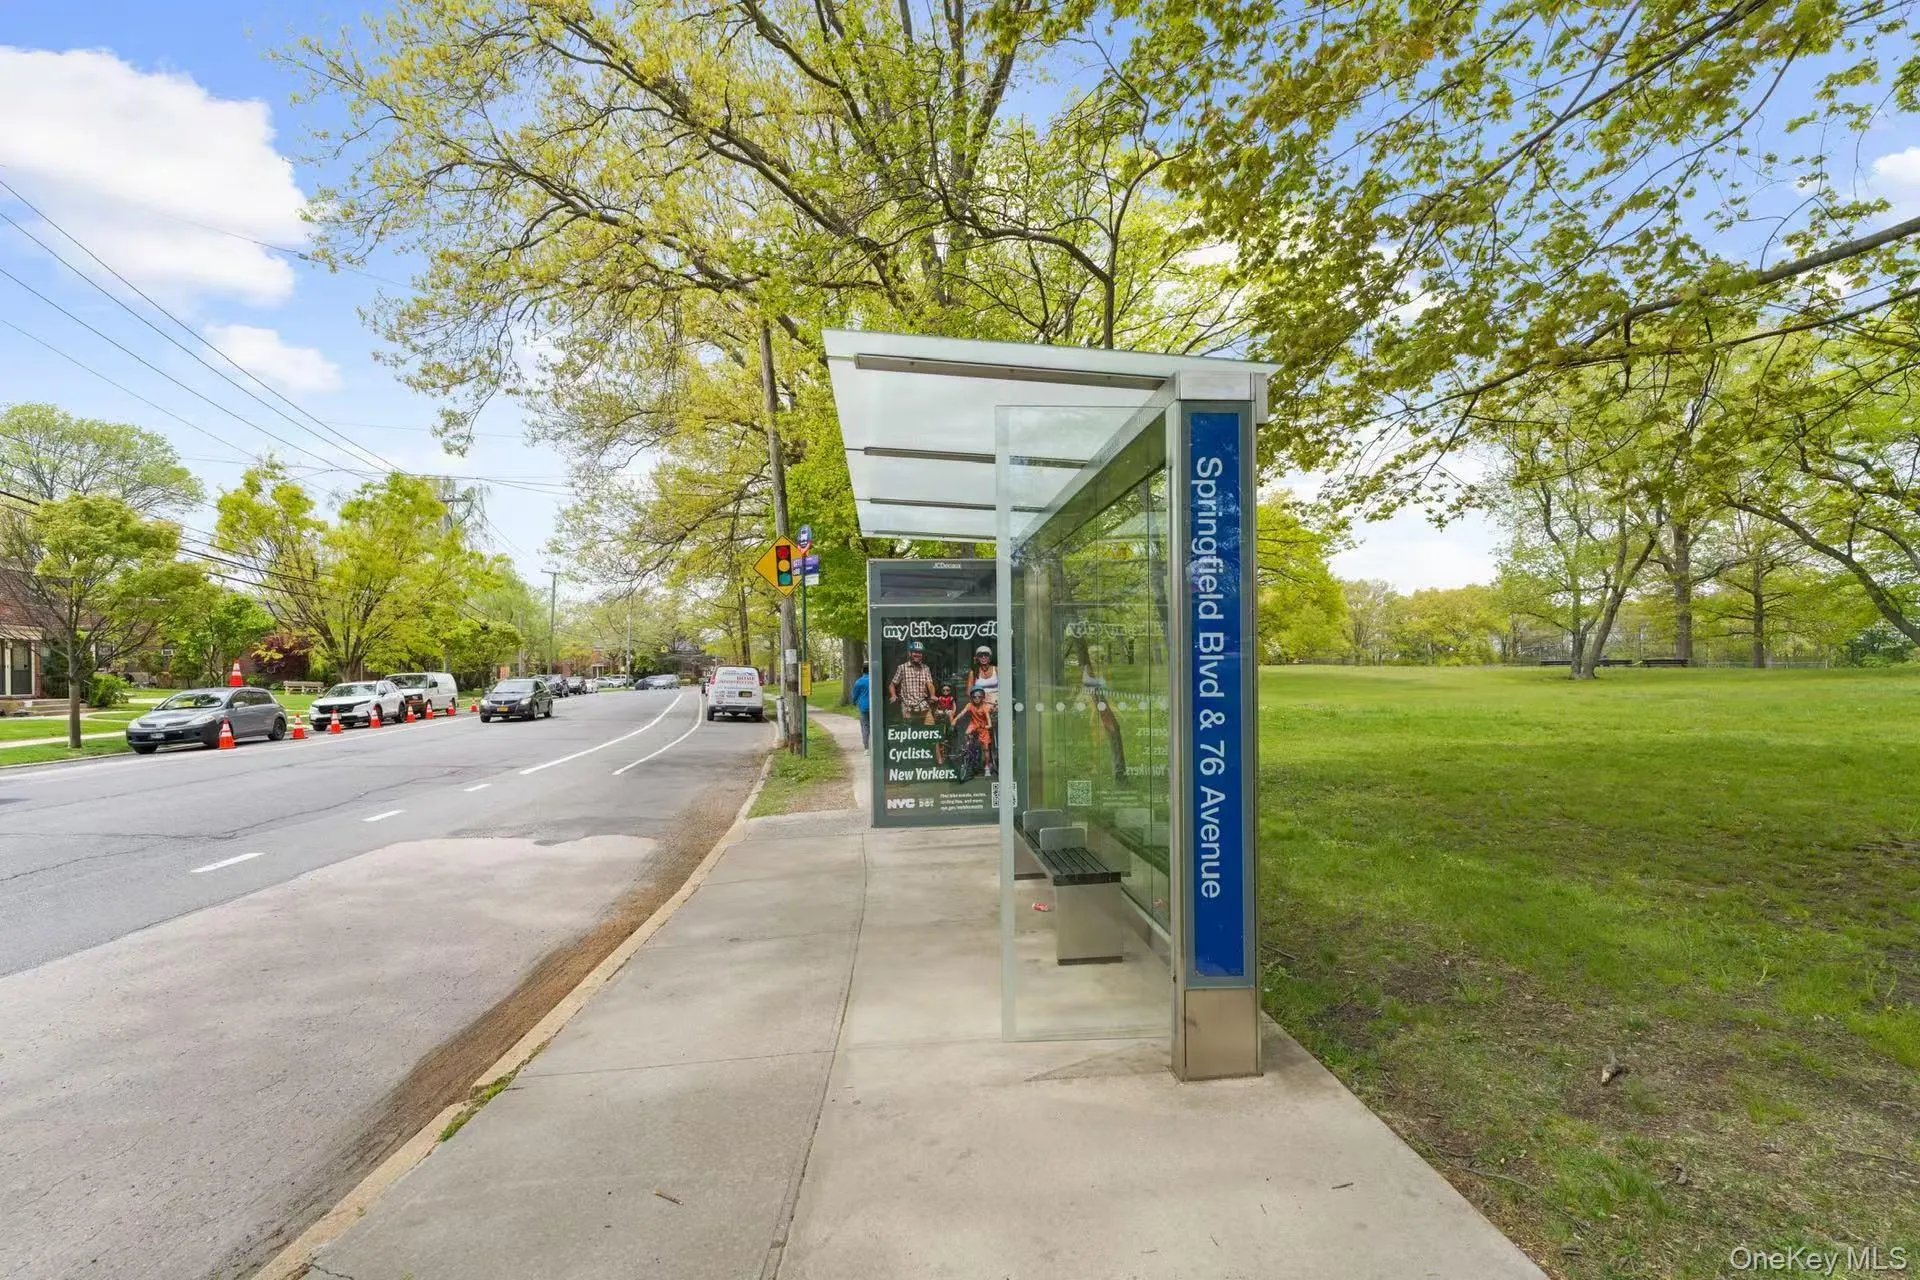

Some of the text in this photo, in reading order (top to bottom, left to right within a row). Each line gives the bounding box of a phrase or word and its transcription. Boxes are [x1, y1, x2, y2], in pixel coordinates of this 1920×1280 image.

[883, 625, 909, 641] my
[910, 621, 948, 640] bike,
[949, 624, 977, 640] my
[1191, 456, 1226, 899] Springfield Blvd & 76 Avenue
[887, 728, 942, 743] Explorers.
[889, 747, 933, 762] Cyclists.
[889, 767, 958, 781] New Yorkers.
[887, 798, 915, 809] NYC
